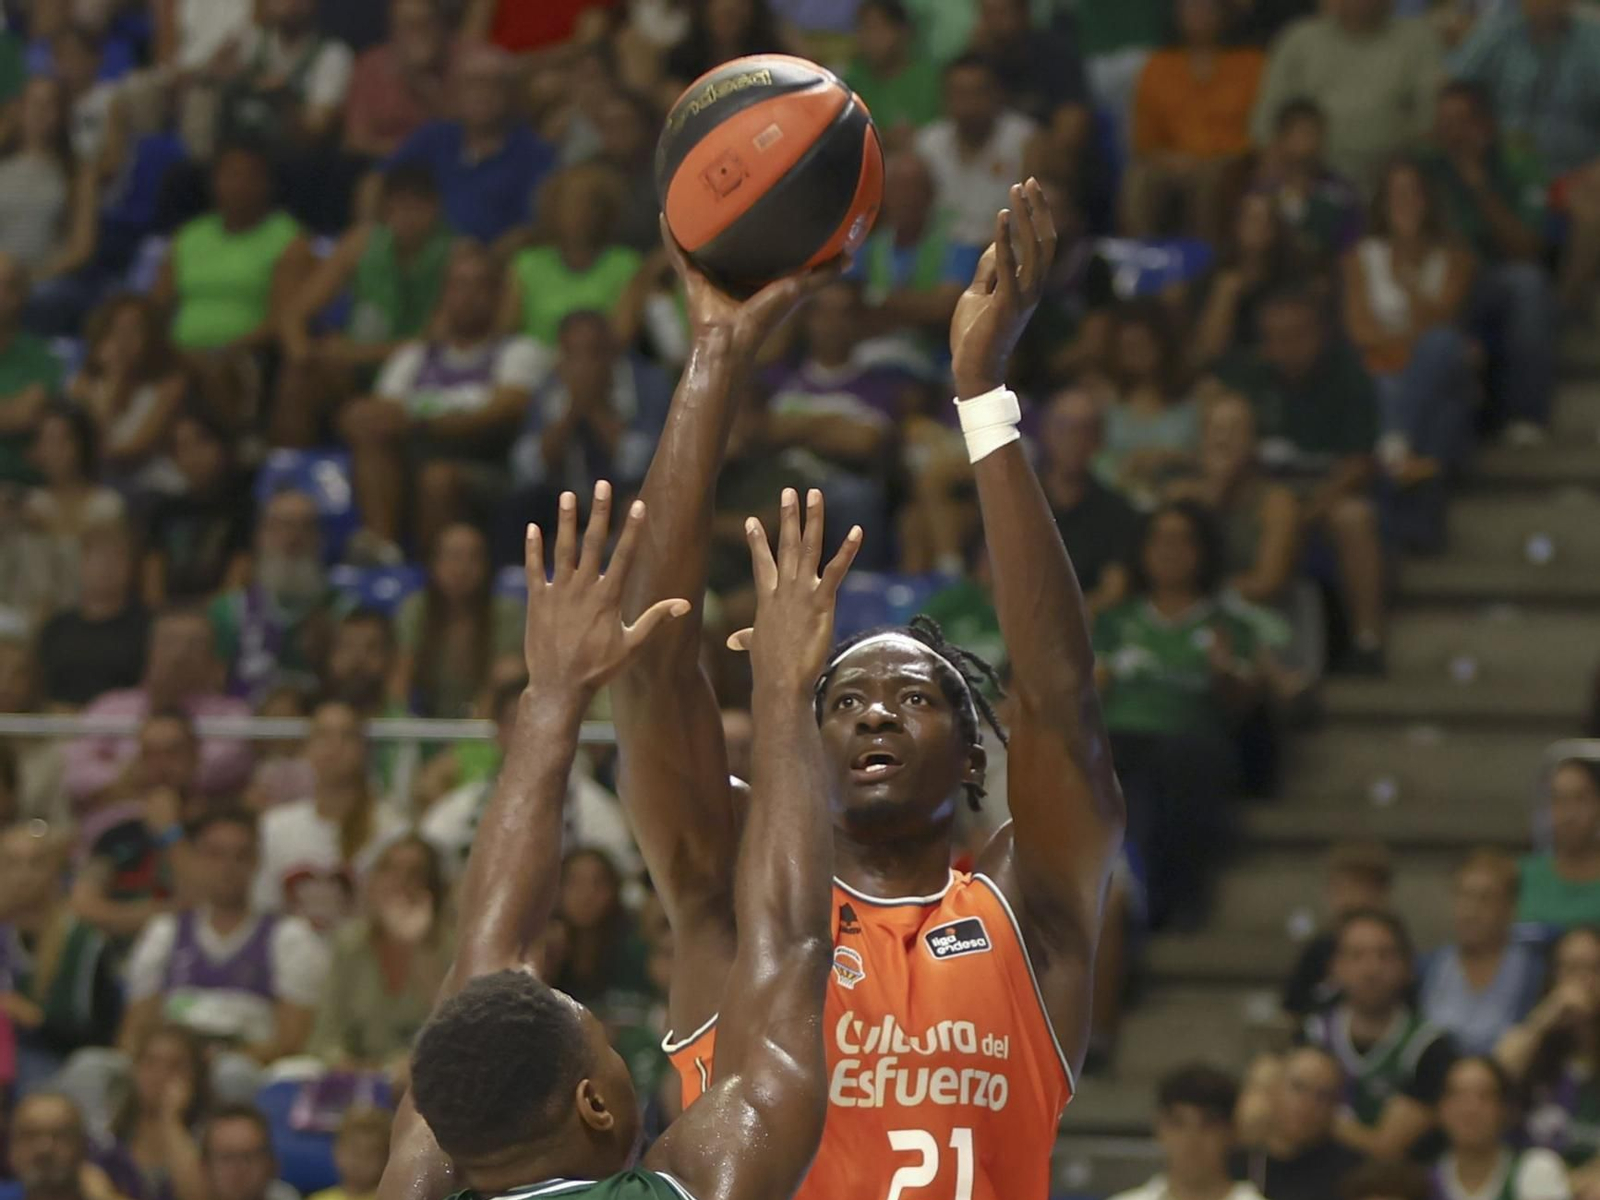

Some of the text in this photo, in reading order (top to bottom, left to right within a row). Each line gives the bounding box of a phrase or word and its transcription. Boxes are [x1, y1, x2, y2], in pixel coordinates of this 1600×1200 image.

[931, 934, 957, 947] liga
[936, 939, 987, 955] endesa
[982, 1033, 1009, 1059] del
[829, 1056, 1008, 1111] Esfuerzo
